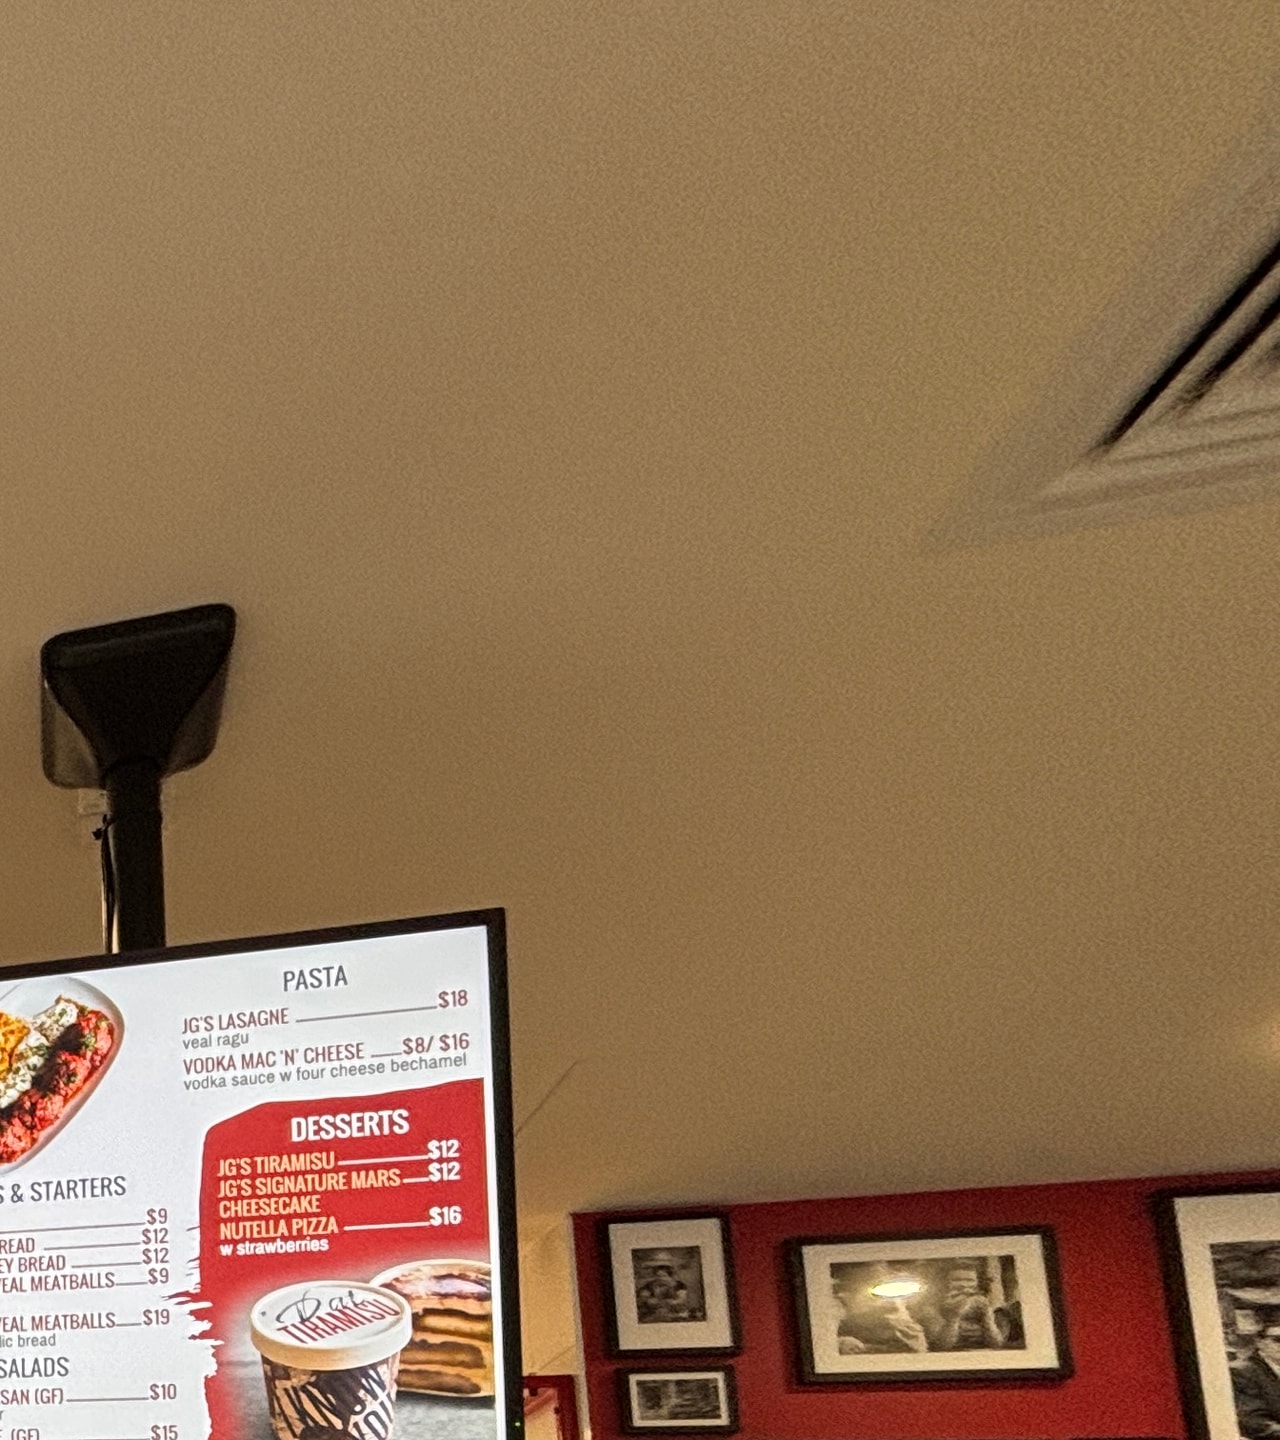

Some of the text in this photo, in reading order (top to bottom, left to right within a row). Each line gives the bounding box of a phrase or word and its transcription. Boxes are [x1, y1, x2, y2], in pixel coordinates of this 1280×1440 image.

[283, 965, 348, 992] PASTA
[218, 1007, 289, 1031] LASAGNE
[437, 989, 468, 1009] $18
[182, 1032, 249, 1050] veal ragu
[182, 1054, 237, 1075] VODKA
[241, 1050, 276, 1070] MAC
[303, 1041, 364, 1064] CHEESE
[439, 1032, 470, 1052] $16
[183, 1052, 467, 1091] vodka sauce w four cheese bechamel
[291, 1109, 410, 1142] DESSERTS
[253, 1150, 335, 1174] TIRAMISU
[427, 1139, 460, 1160] $12
[10, 1183, 24, 1204] &
[30, 1175, 126, 1202] STARTERS
[254, 1171, 348, 1195] SIGNATURE
[351, 1167, 402, 1189] MARS
[427, 1161, 460, 1182] $12
[146, 1207, 168, 1225] $9
[219, 1194, 321, 1218] CHEESECAKE
[219, 1205, 462, 1240] NUTELLA PIZZA $16
[141, 1227, 169, 1245] $12
[219, 1236, 329, 1256] w strawberries
[18, 1254, 66, 1273] BREAD
[142, 1247, 169, 1265] $12
[30, 1272, 115, 1292] MEATBALLS
[147, 1267, 169, 1285] $9
[31, 1312, 117, 1331] MEATBALLS
[142, 1308, 170, 1326] $19
[276, 1298, 401, 1344] TIRAMISU
[17, 1332, 56, 1348] bread
[34, 1387, 67, 1405] (GF)
[149, 1383, 177, 1401] $10
